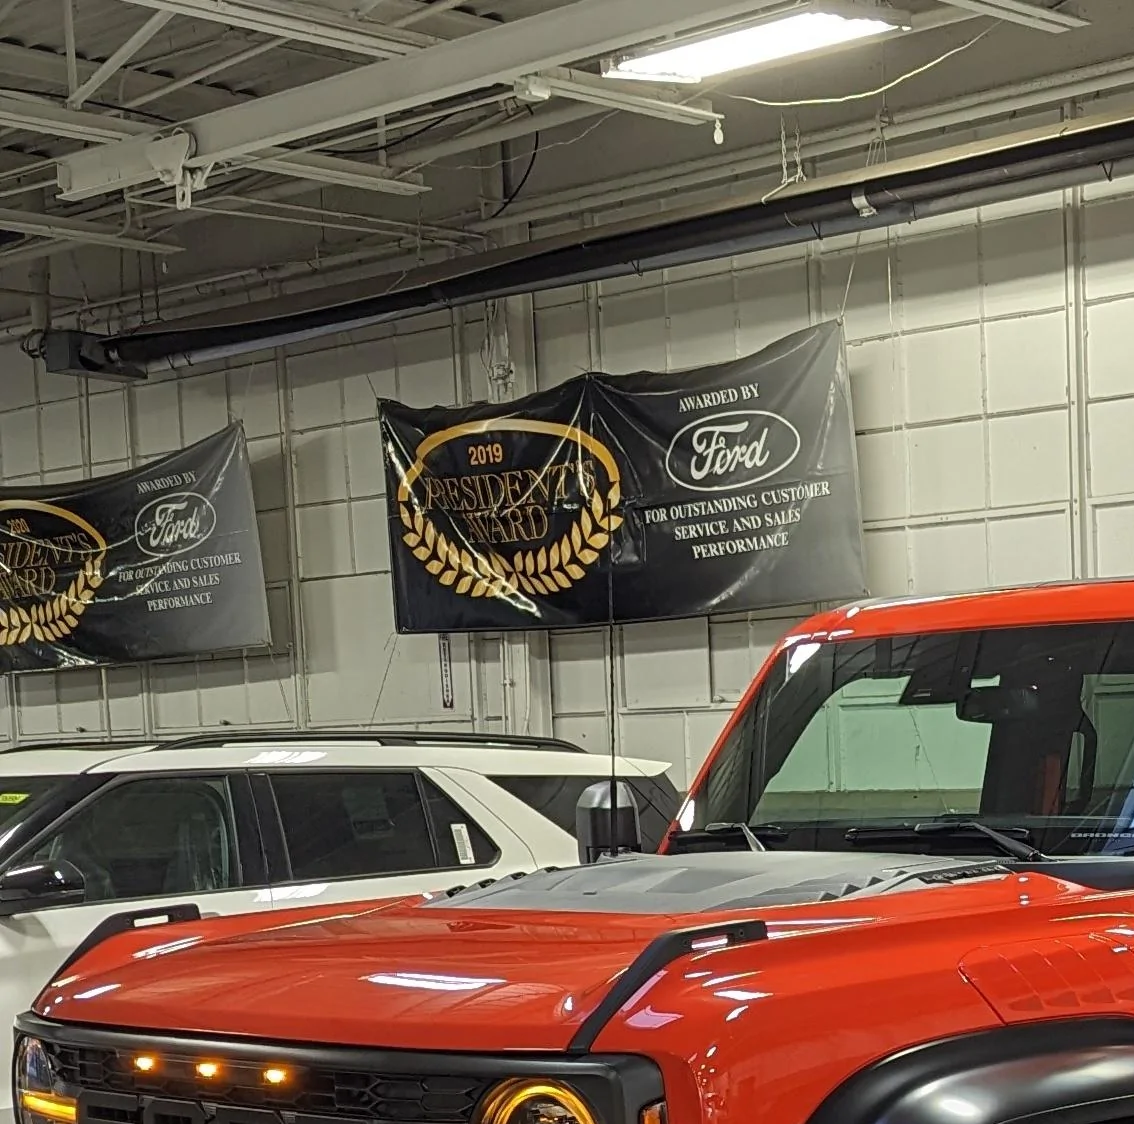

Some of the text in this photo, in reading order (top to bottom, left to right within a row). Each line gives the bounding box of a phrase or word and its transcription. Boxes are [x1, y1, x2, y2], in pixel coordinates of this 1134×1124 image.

[678, 383, 760, 412] AWARDED BY
[468, 443, 503, 466] 2019
[691, 421, 770, 480] Ford
[137, 470, 196, 494] AWARDED BY
[644, 481, 831, 524] FOR OUTSTANDING CUSTOMER
[150, 501, 200, 547] Ford
[674, 508, 801, 541] SERVICE AND SALES
[692, 532, 789, 559] PERFORMANCE
[119, 552, 241, 582] FOR OUTSTANDING CUSTOMER
[136, 573, 220, 595] SERVICE AND SALES
[146, 592, 213, 611] PERFORMANCE
